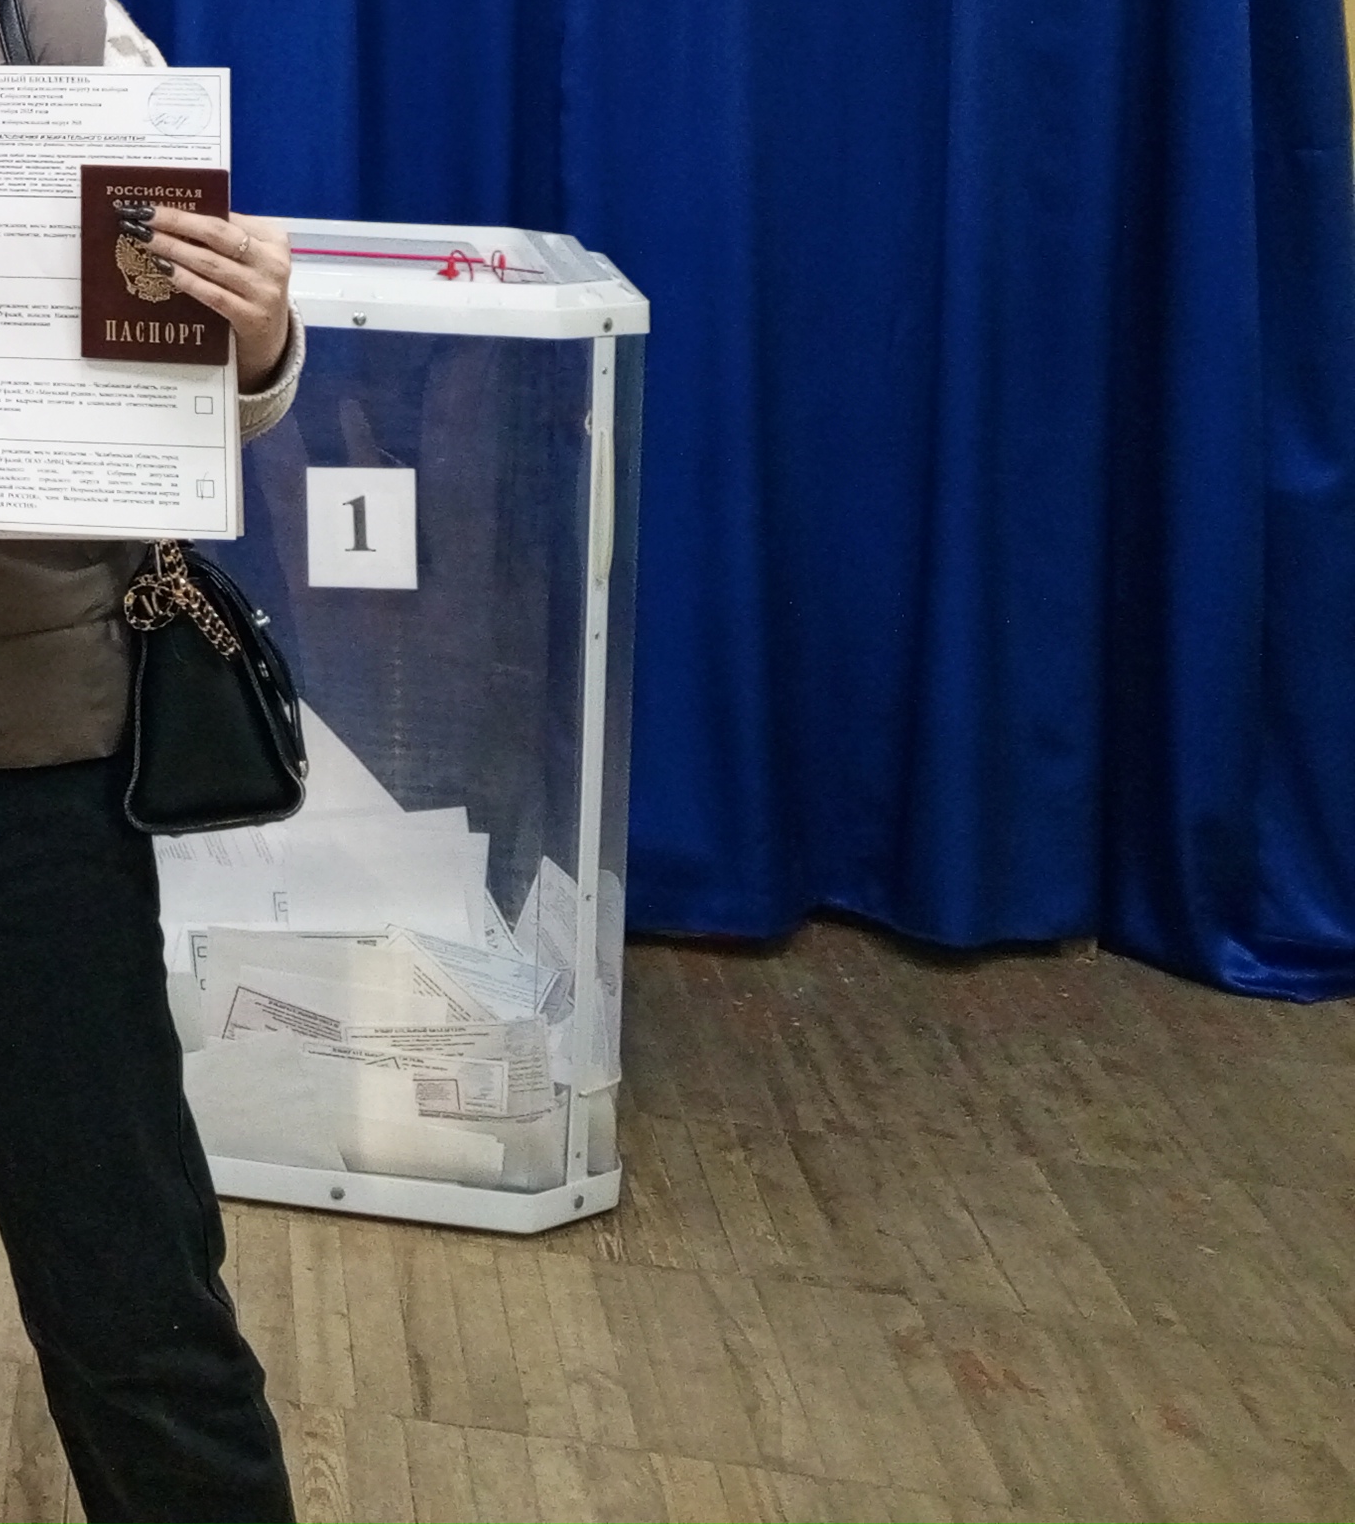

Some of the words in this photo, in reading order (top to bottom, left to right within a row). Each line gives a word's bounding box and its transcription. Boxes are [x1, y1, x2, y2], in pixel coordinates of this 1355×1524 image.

[106, 185, 203, 198] РОССИЙСКАЯ
[105, 319, 205, 345] ПАСПОРТ
[342, 494, 376, 552] 1
